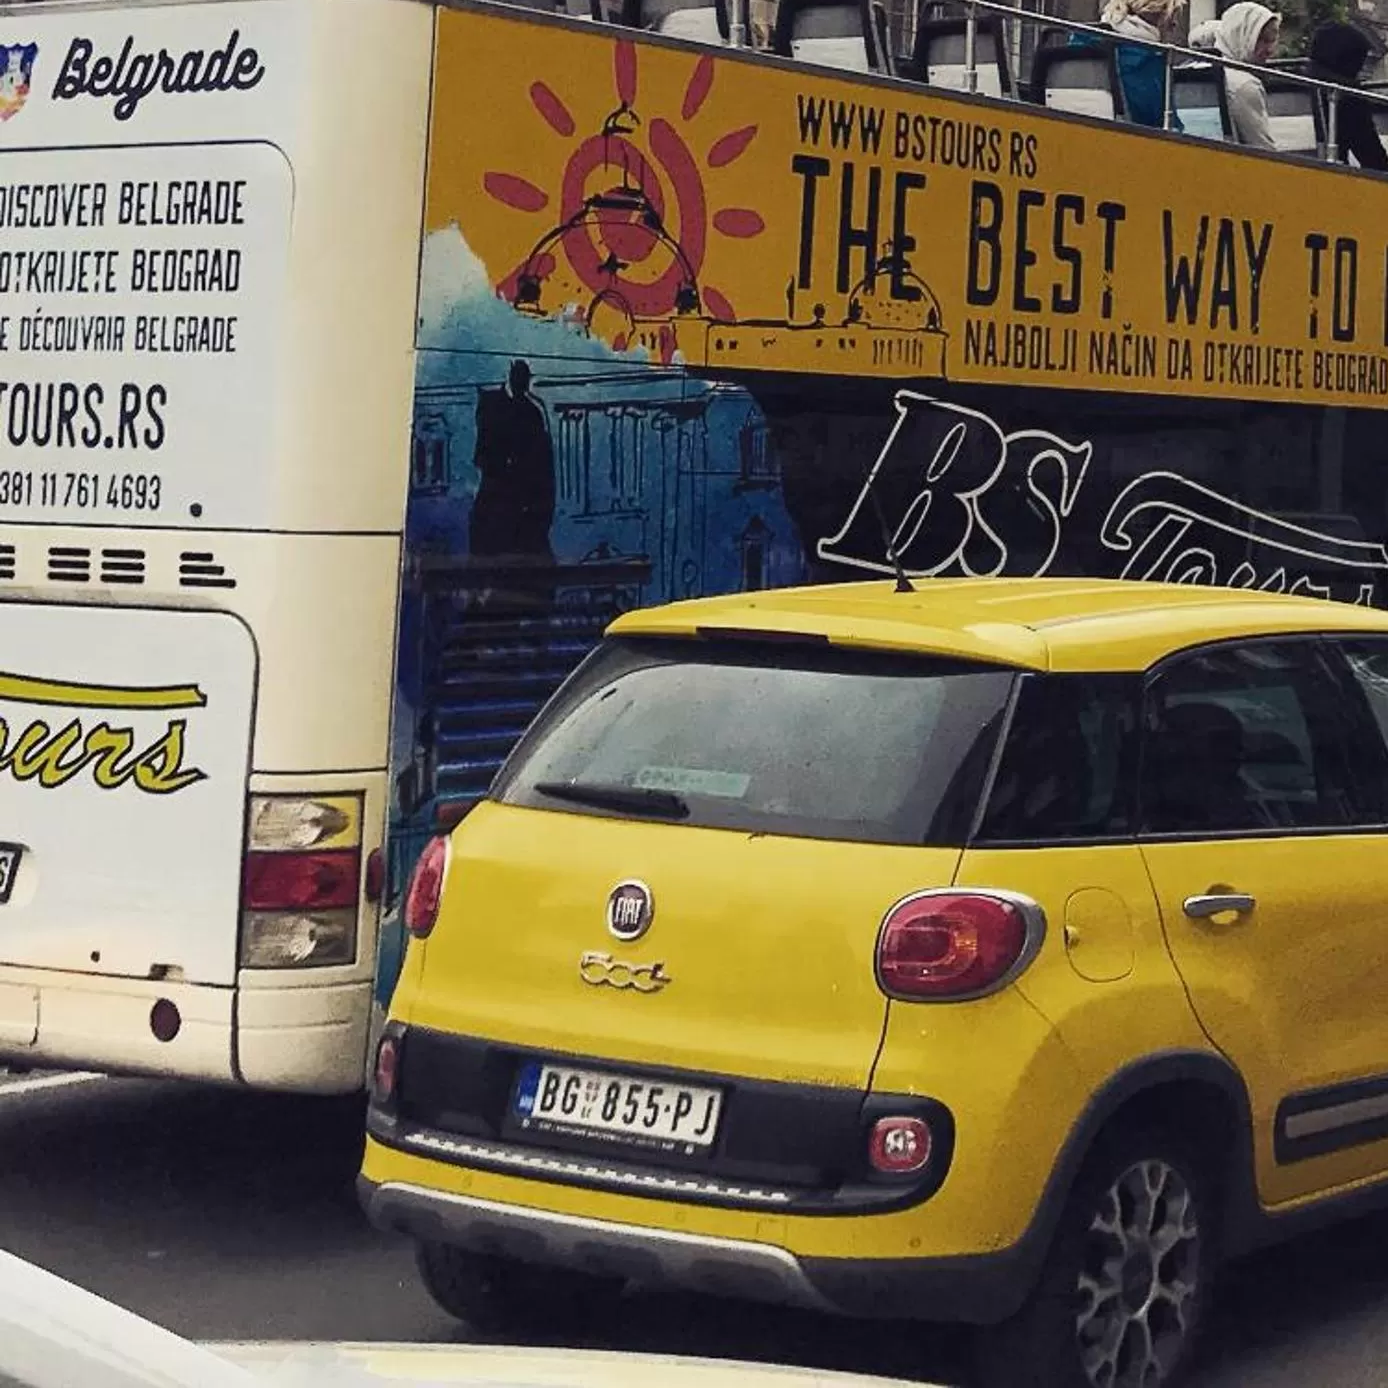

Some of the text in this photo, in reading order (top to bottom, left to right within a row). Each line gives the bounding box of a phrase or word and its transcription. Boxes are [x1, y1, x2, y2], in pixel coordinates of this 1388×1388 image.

[52, 30, 265, 120] Belgrade
[118, 180, 247, 227] BELGRADE
[0, 248, 241, 293] OTKRIJETE BEOGRAD
[791, 155, 926, 302] THE
[966, 180, 1127, 320] BEST
[1161, 209, 1275, 334] WAY
[1304, 233, 1358, 342] TO
[19, 307, 125, 352] DÉCOUVRIR
[135, 315, 238, 353] BELGRADE
[964, 319, 1078, 373] NAJBOLJI
[1088, 323, 1157, 378] NAČIN
[1167, 338, 1193, 381] DA
[1203, 341, 1304, 390] OTKRIJETE
[106, 474, 161, 510] 4693
[817, 389, 1092, 579] BS
[0, 670, 208, 795] urs
[614, 897, 644, 925] FIAT
[539, 1071, 581, 1115] BG
